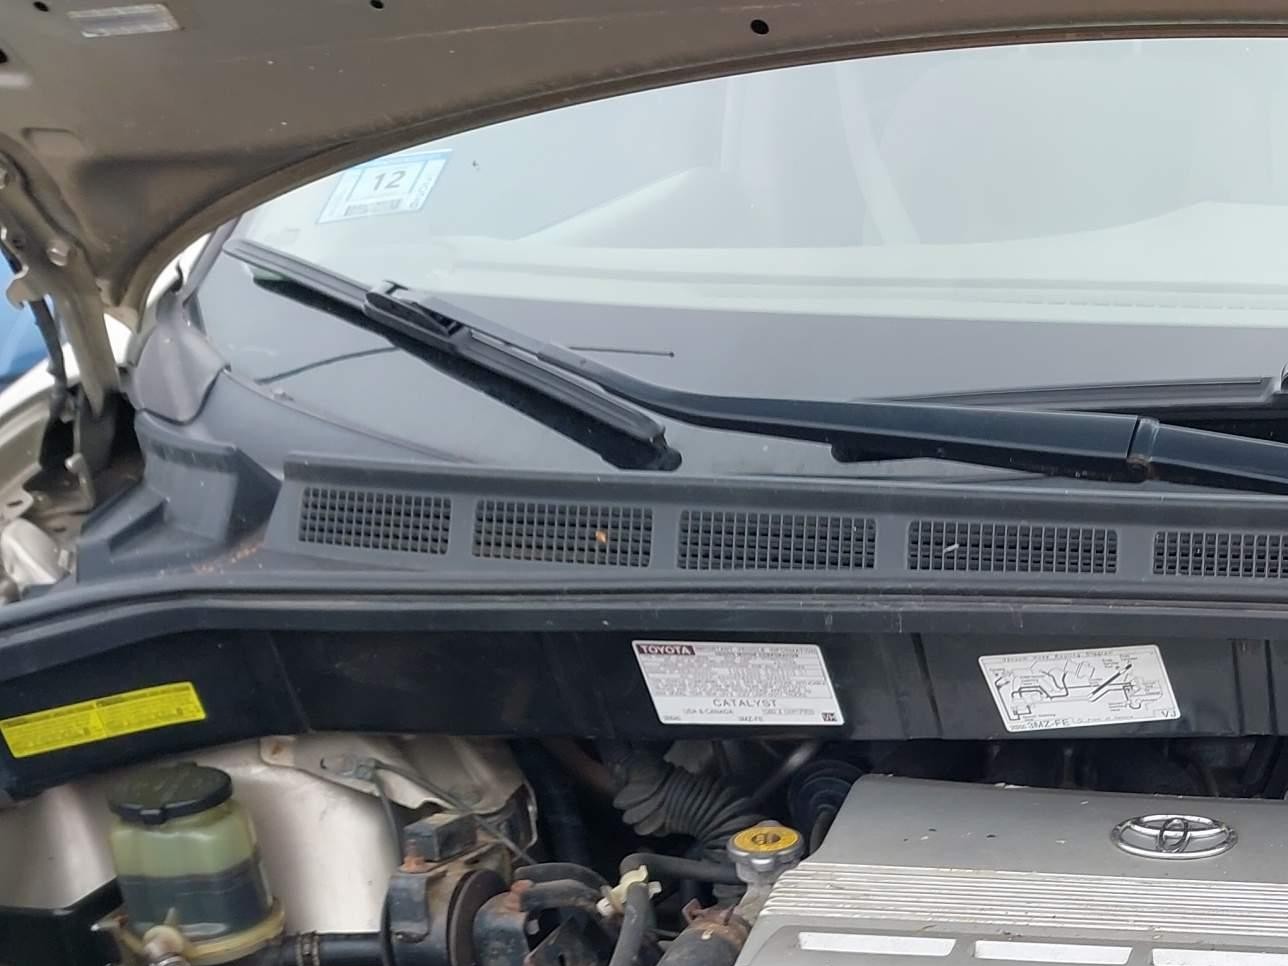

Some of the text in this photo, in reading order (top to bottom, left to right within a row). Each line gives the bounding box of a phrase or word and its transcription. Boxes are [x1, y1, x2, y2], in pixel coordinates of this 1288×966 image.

[374, 170, 406, 191] 12
[639, 645, 692, 655] TOYOTA
[713, 699, 777, 708] CATALYST
